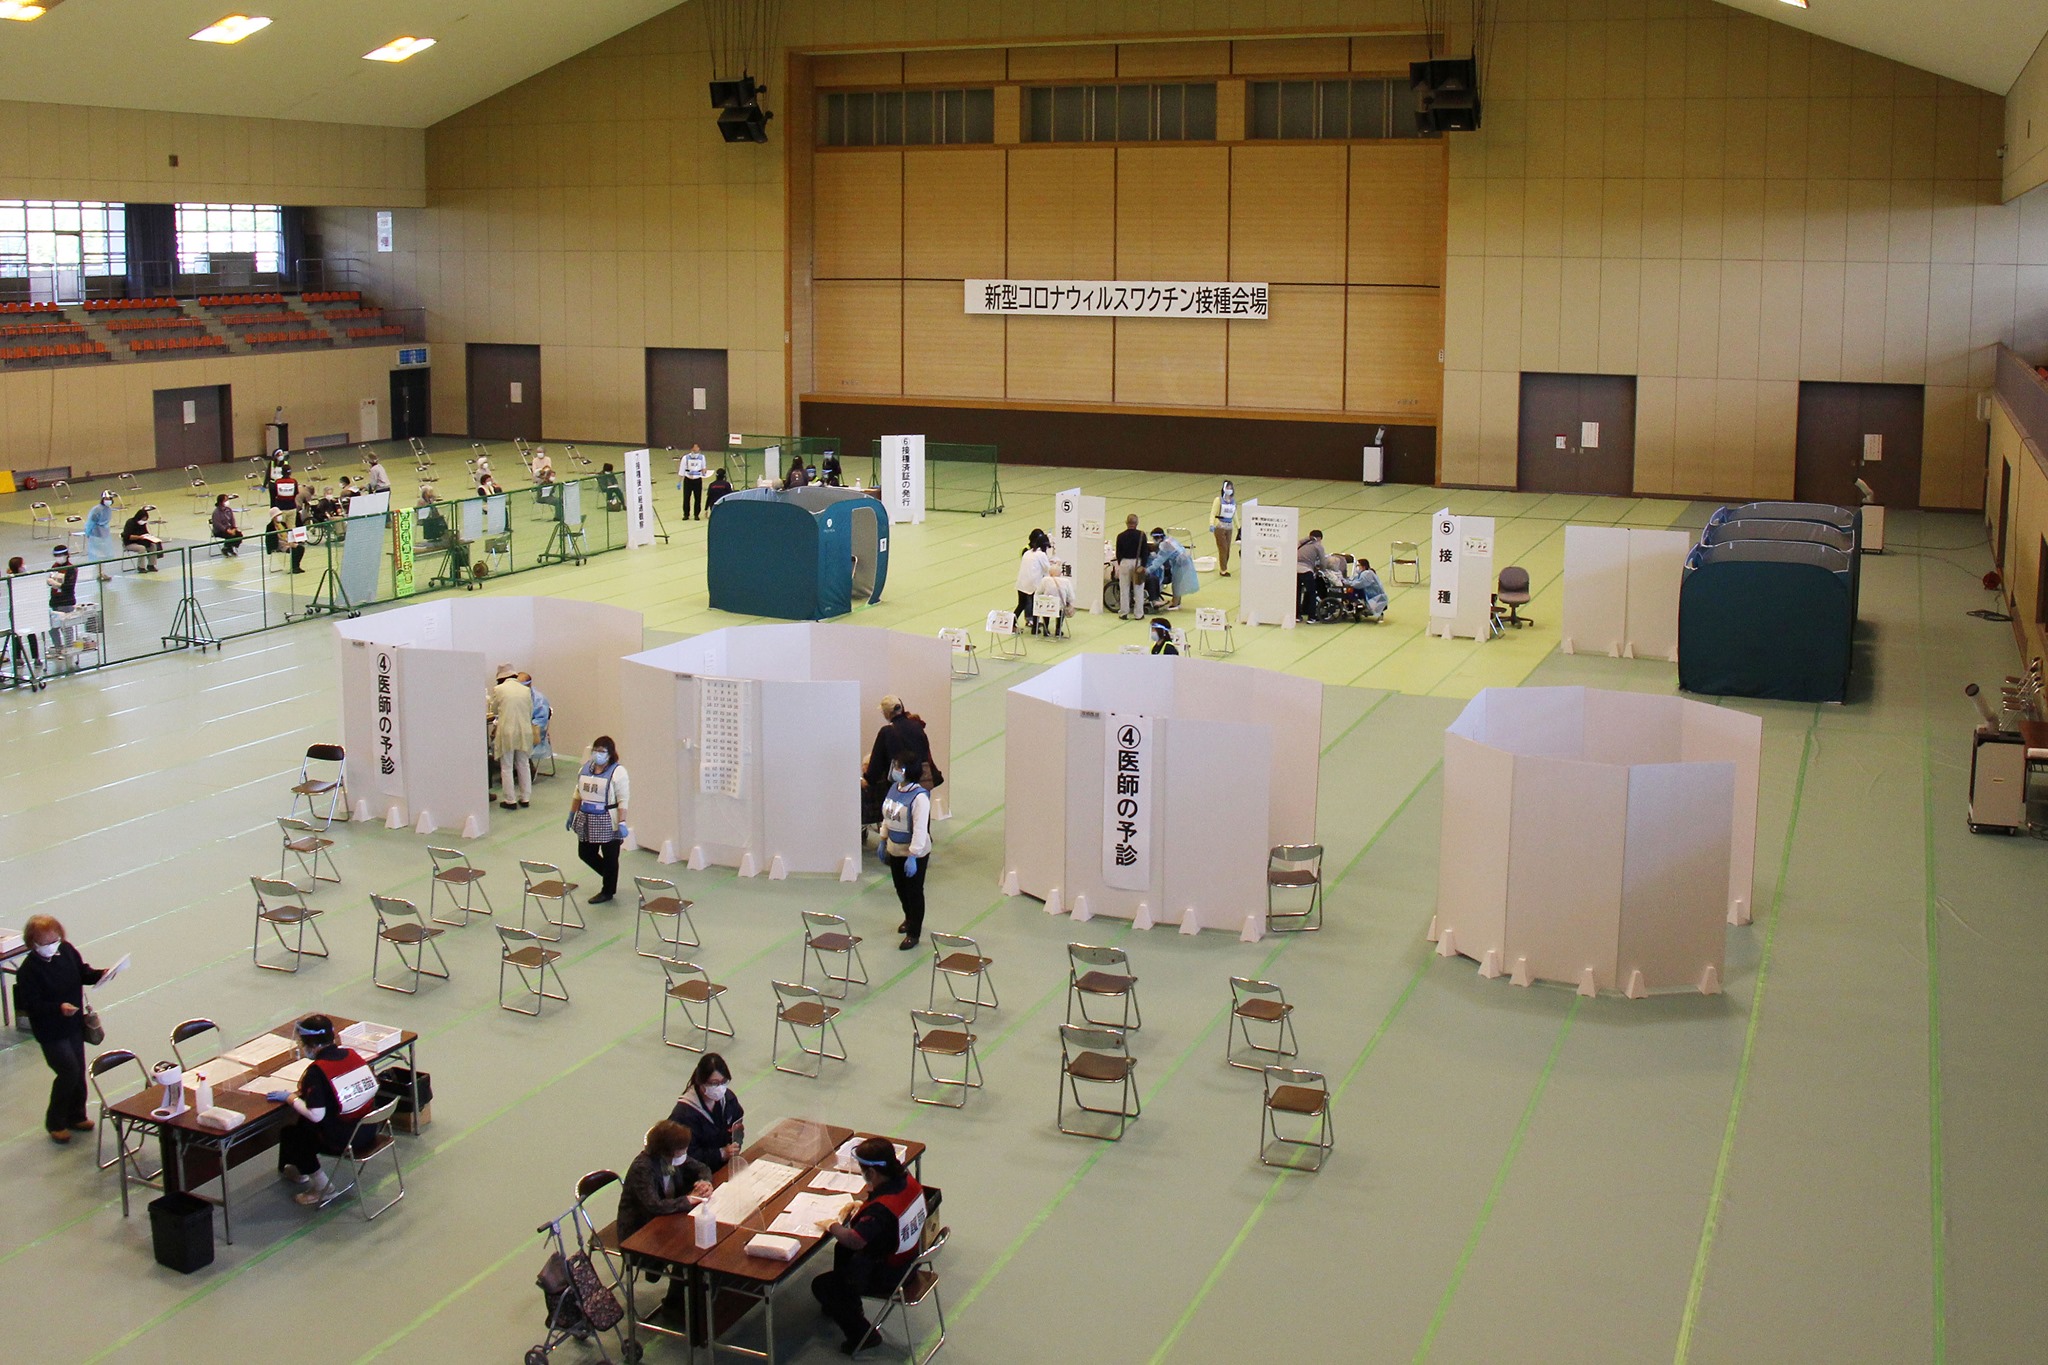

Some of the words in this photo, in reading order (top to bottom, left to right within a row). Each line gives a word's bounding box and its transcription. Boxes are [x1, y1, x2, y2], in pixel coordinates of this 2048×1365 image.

[985, 283, 1268, 315] 新型コロナウィルスワクチン接種会場
[377, 652, 395, 775] ④医師の予診
[1115, 725, 1141, 866] ④医師の予診
